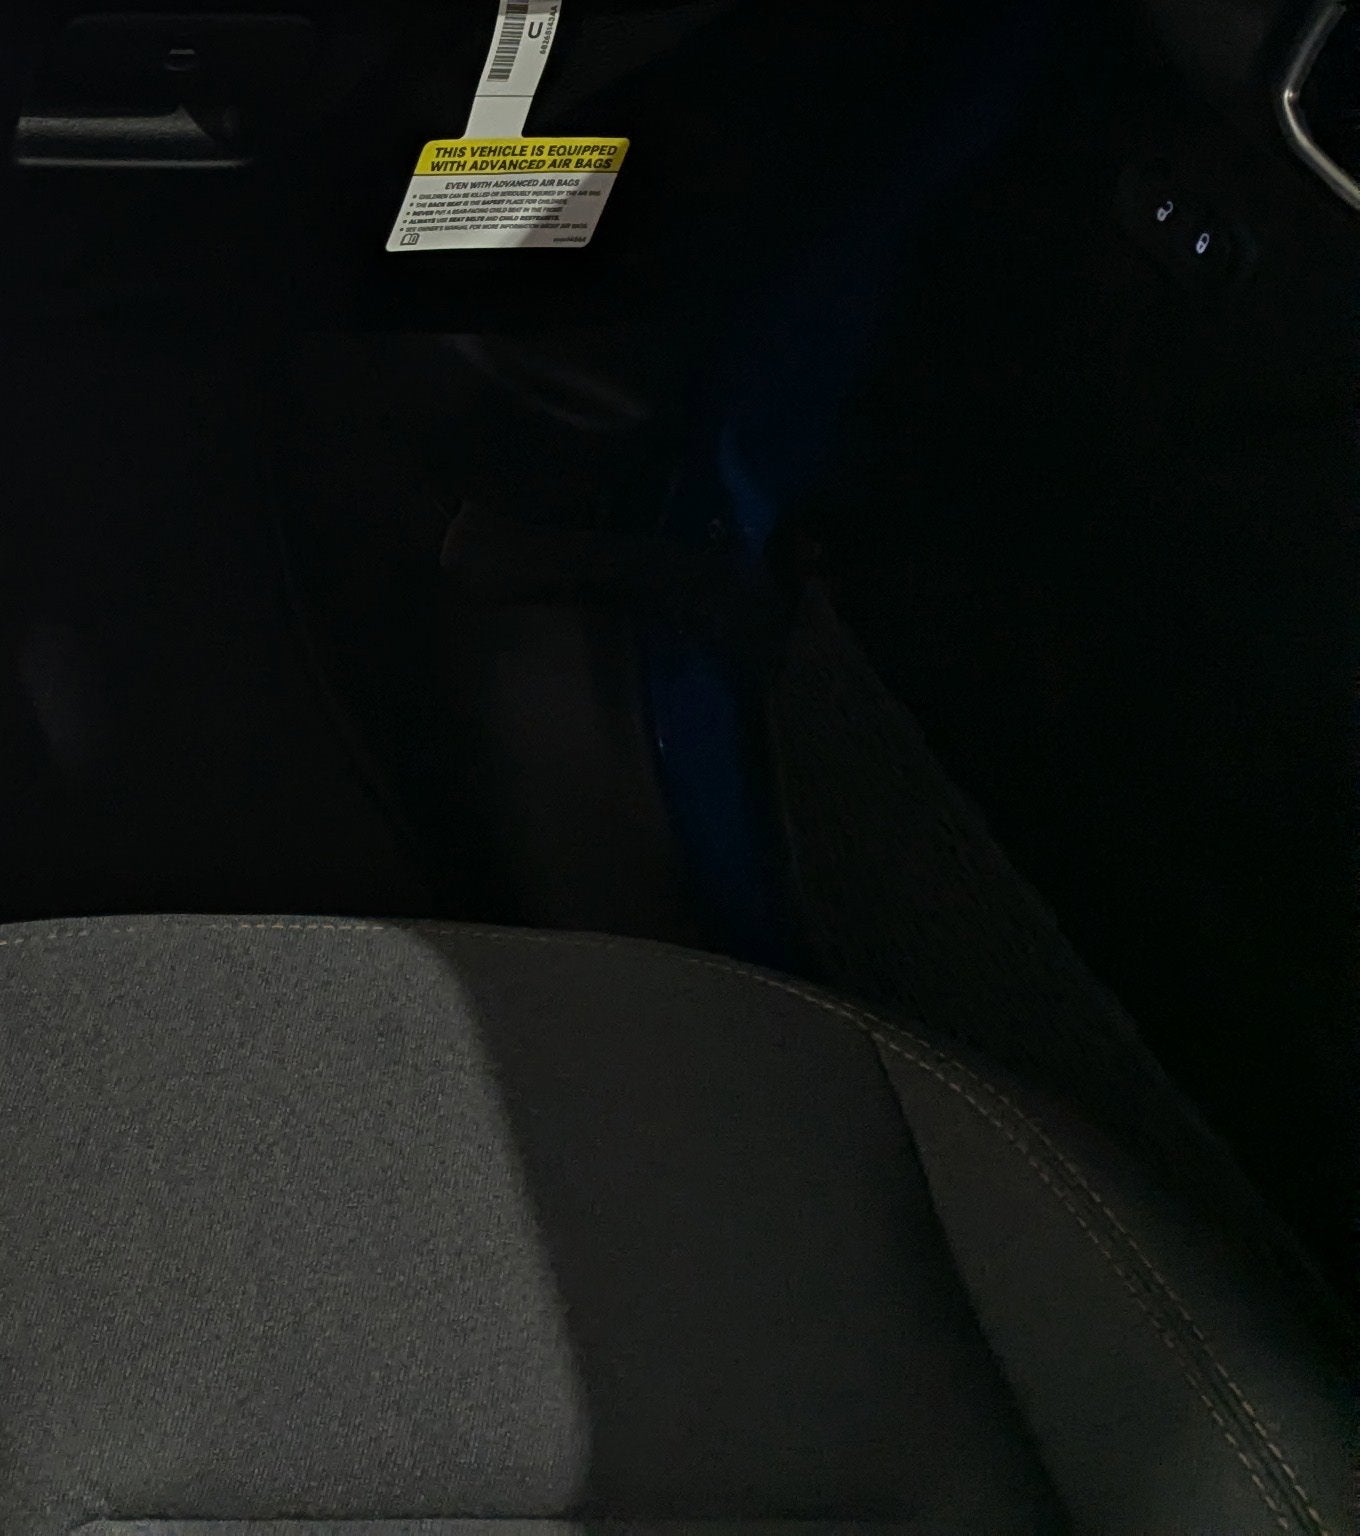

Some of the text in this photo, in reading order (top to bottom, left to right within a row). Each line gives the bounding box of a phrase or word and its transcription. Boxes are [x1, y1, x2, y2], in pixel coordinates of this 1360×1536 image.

[528, 21, 544, 39] U
[435, 145, 618, 158] THIS VEHICLE IS EQUIPPED
[430, 158, 613, 172] WITH ADVANCED AIR BAGS
[444, 178, 580, 190] EVEN WITH ADVANCED AIR BAGS
